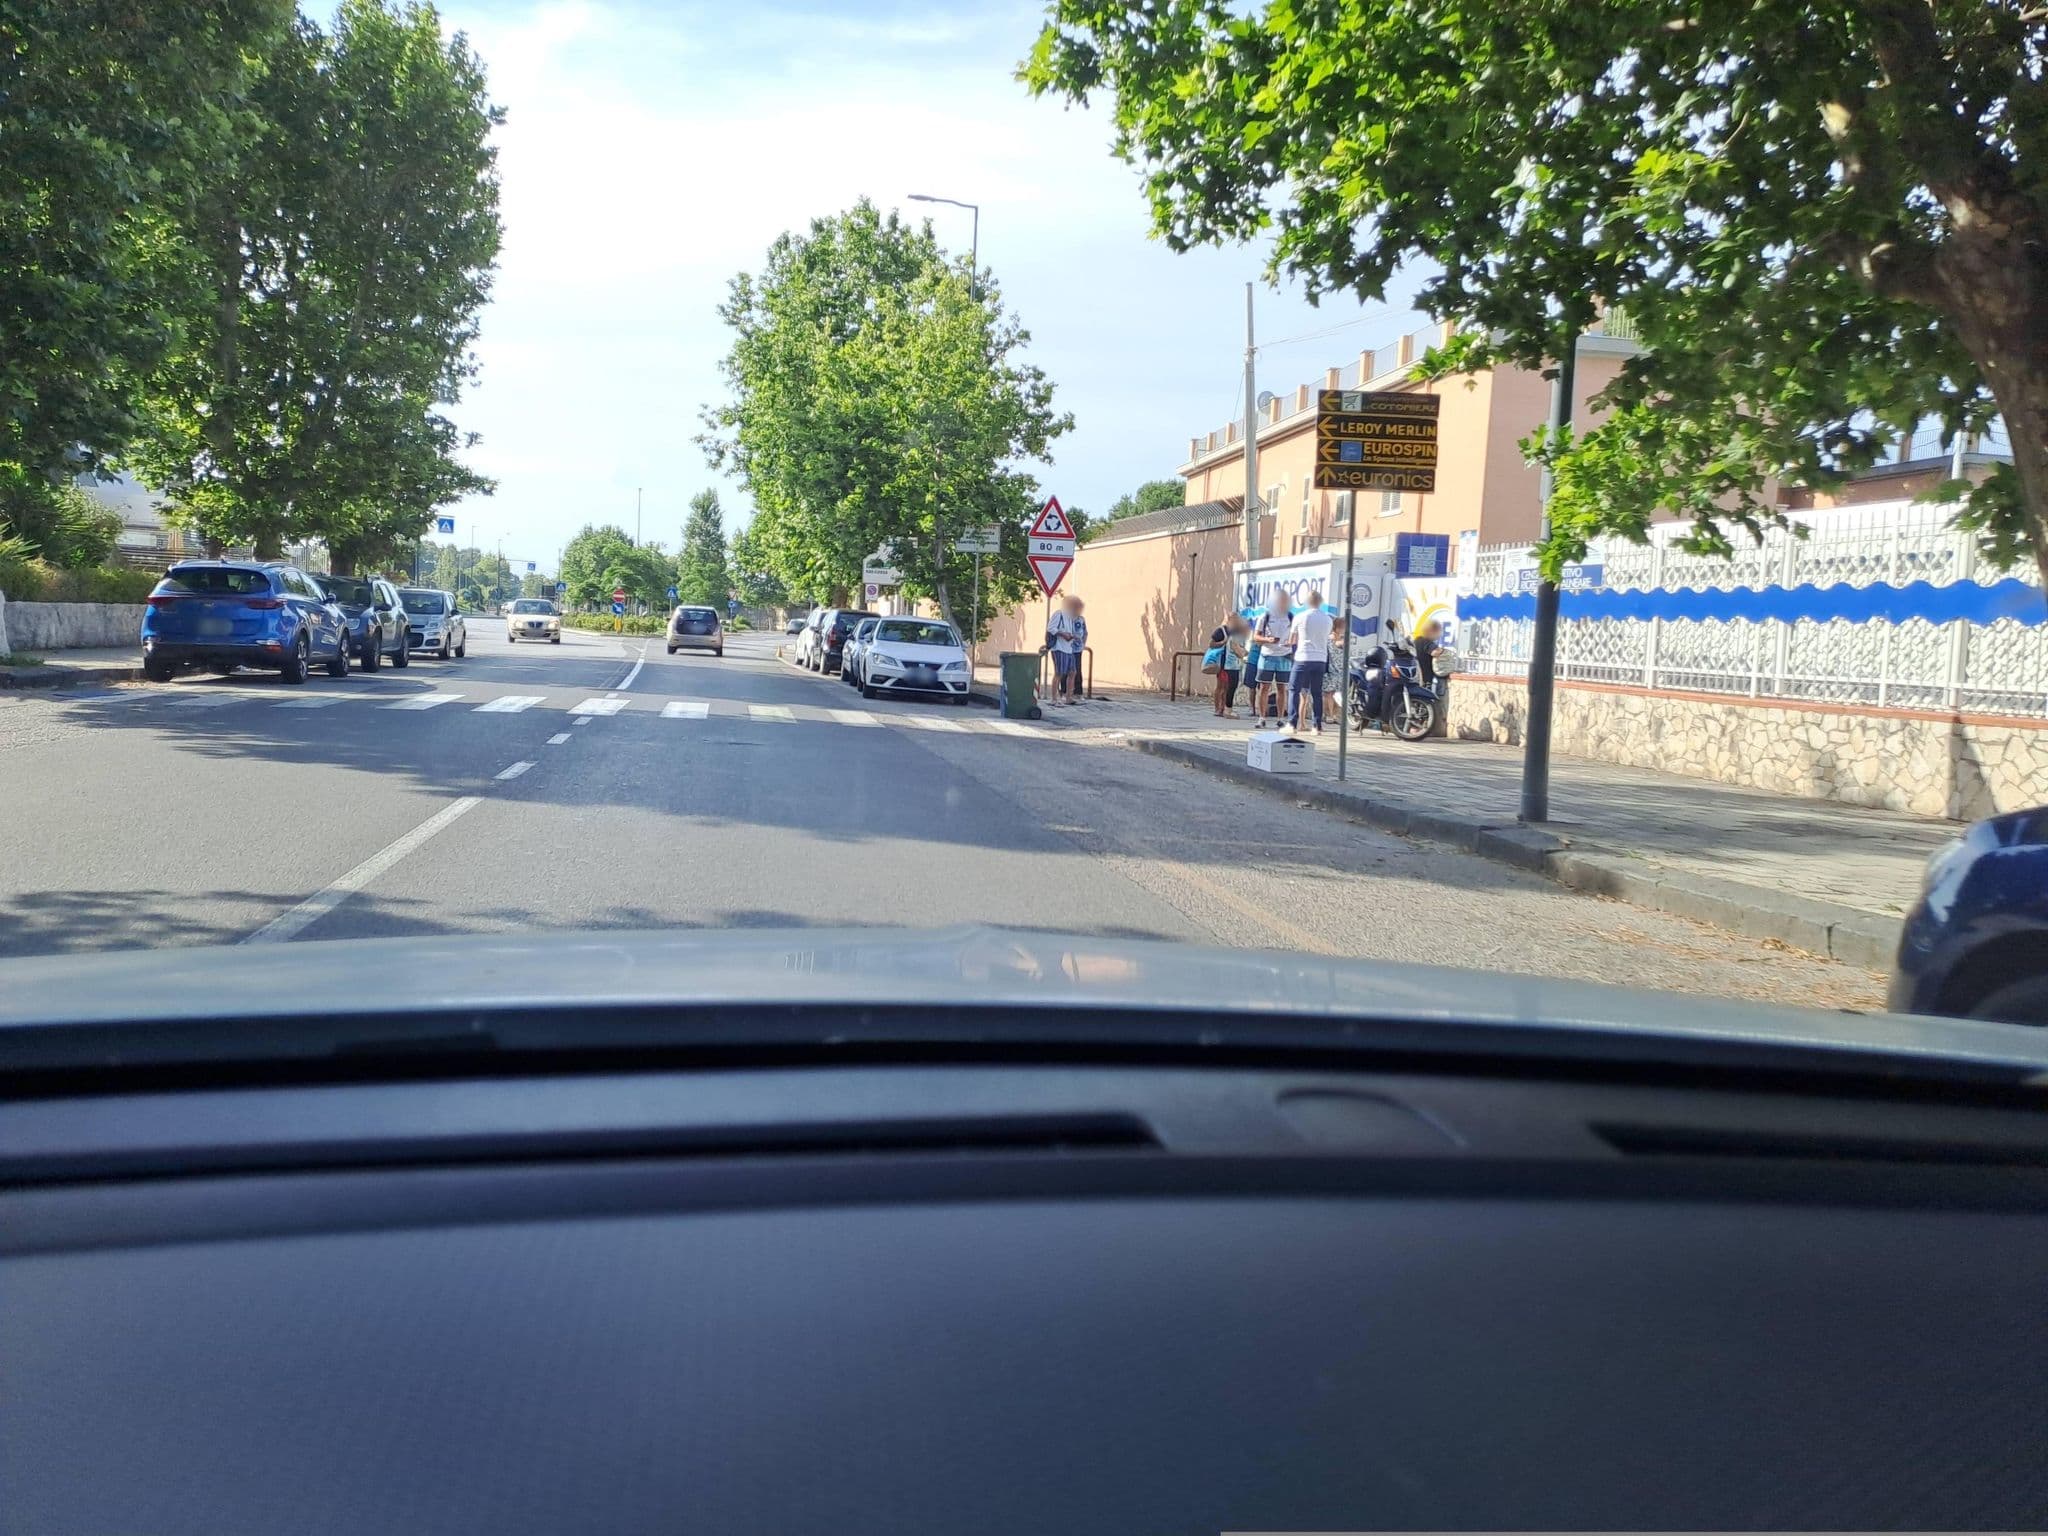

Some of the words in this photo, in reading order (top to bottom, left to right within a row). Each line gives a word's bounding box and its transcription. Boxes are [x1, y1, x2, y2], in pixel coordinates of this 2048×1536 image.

[1340, 422, 1382, 435] LEROY
[1385, 424, 1436, 436] MERLIN
[1363, 442, 1436, 457] EUROSPIN
[1350, 471, 1433, 488] euronics
[1040, 543, 1052, 551] 80
